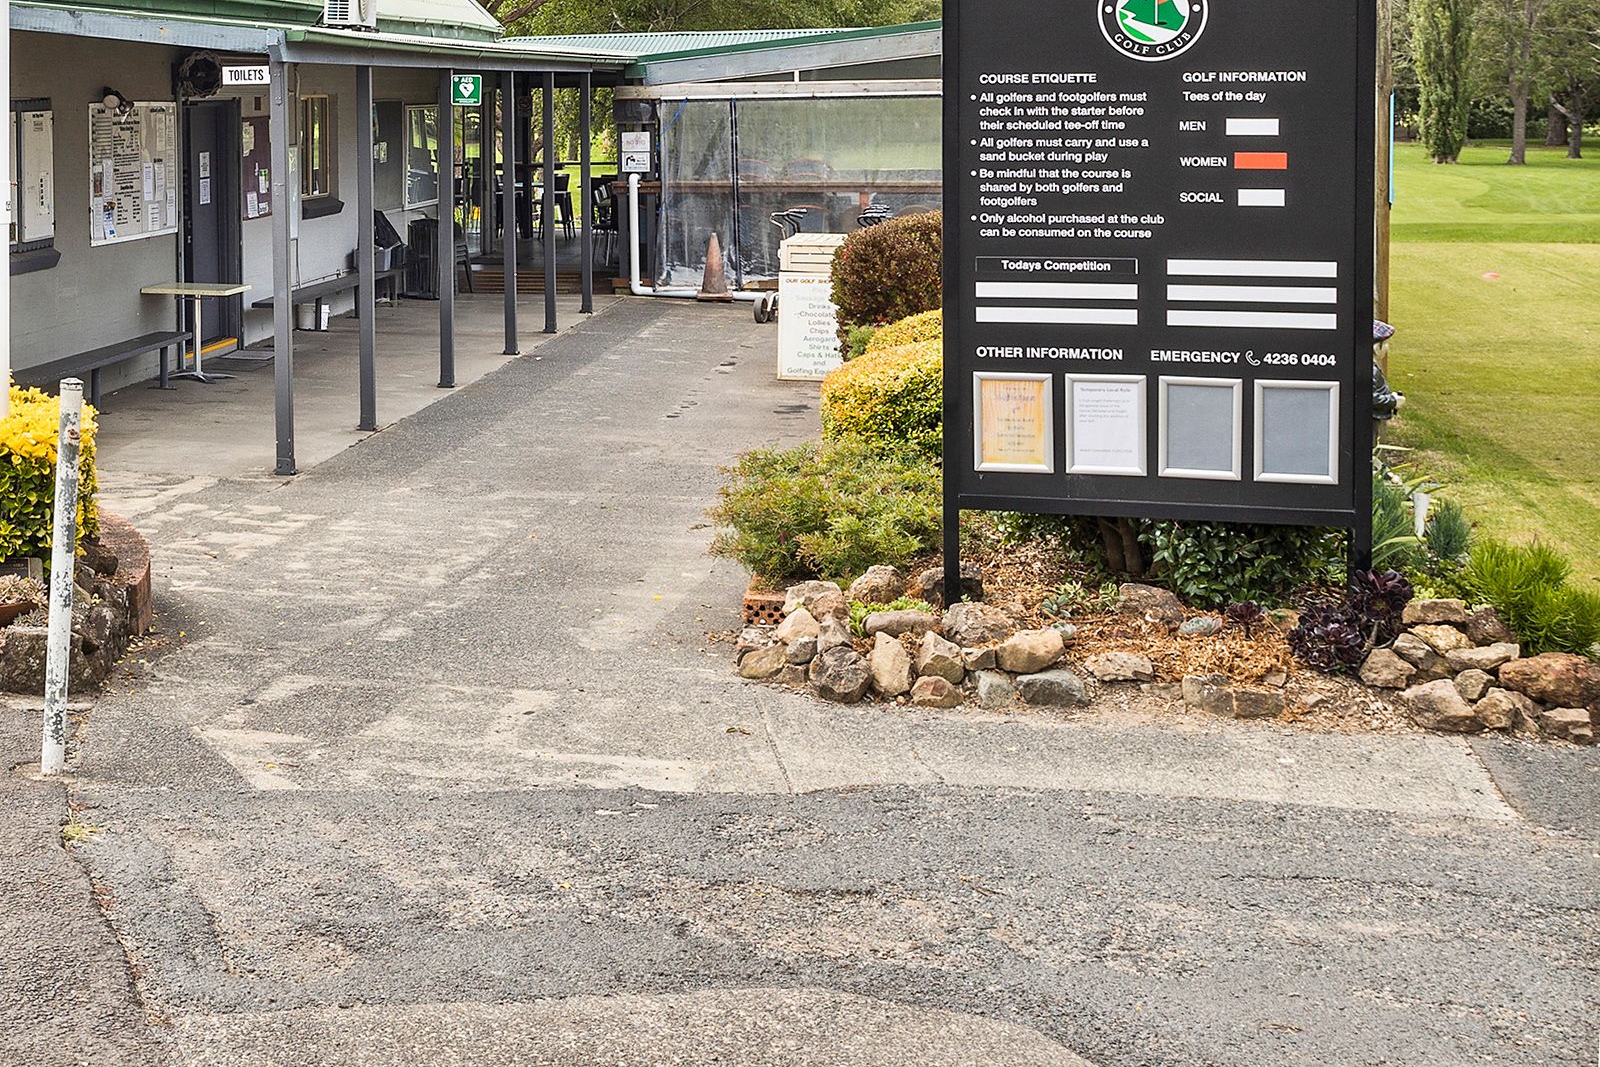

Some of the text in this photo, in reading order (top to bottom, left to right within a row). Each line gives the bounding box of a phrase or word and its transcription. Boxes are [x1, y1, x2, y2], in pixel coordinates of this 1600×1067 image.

[1114, 31, 1192, 54] GOLF CLUB
[228, 69, 264, 81] TOILETS
[980, 73, 1097, 84] COURSE ETIQUETTE
[1182, 72, 1307, 82] GOLF INFORMATION
[980, 92, 1147, 104] All golfers and footgolfers must
[1182, 91, 1266, 103] Tees of the day
[980, 106, 1144, 116] check in with the starter before
[980, 120, 1126, 130] their scheduled tee-off time
[1180, 121, 1206, 131] MEN
[980, 138, 994, 147] All
[996, 138, 1033, 150] golfers
[1036, 138, 1062, 147] must
[1065, 139, 1093, 150] carry
[1095, 138, 1116, 147] and
[1141, 139, 1149, 147] a
[980, 152, 1108, 164] sand bucket during play
[1180, 156, 1227, 167] WOMEN
[980, 169, 1131, 178] Be mindful that the course is
[980, 183, 1123, 195] shared by both golfers and
[980, 196, 1037, 208] footgolfers
[1180, 192, 1223, 203] SOCIAL
[980, 213, 1164, 226] Only alcohol purchased at the club
[980, 227, 1152, 238] can be consumed on the course
[1001, 260, 1111, 273] Todays Competition
[809, 327, 829, 335] Chips
[803, 335, 836, 344] Aerogard
[808, 343, 829, 351] Shirts
[797, 351, 815, 359] Caps
[976, 346, 1123, 361] OTHER INFORMATION
[1150, 350, 1337, 366] EMERGENCY 4236 0404
[787, 367, 813, 376] Golfing
